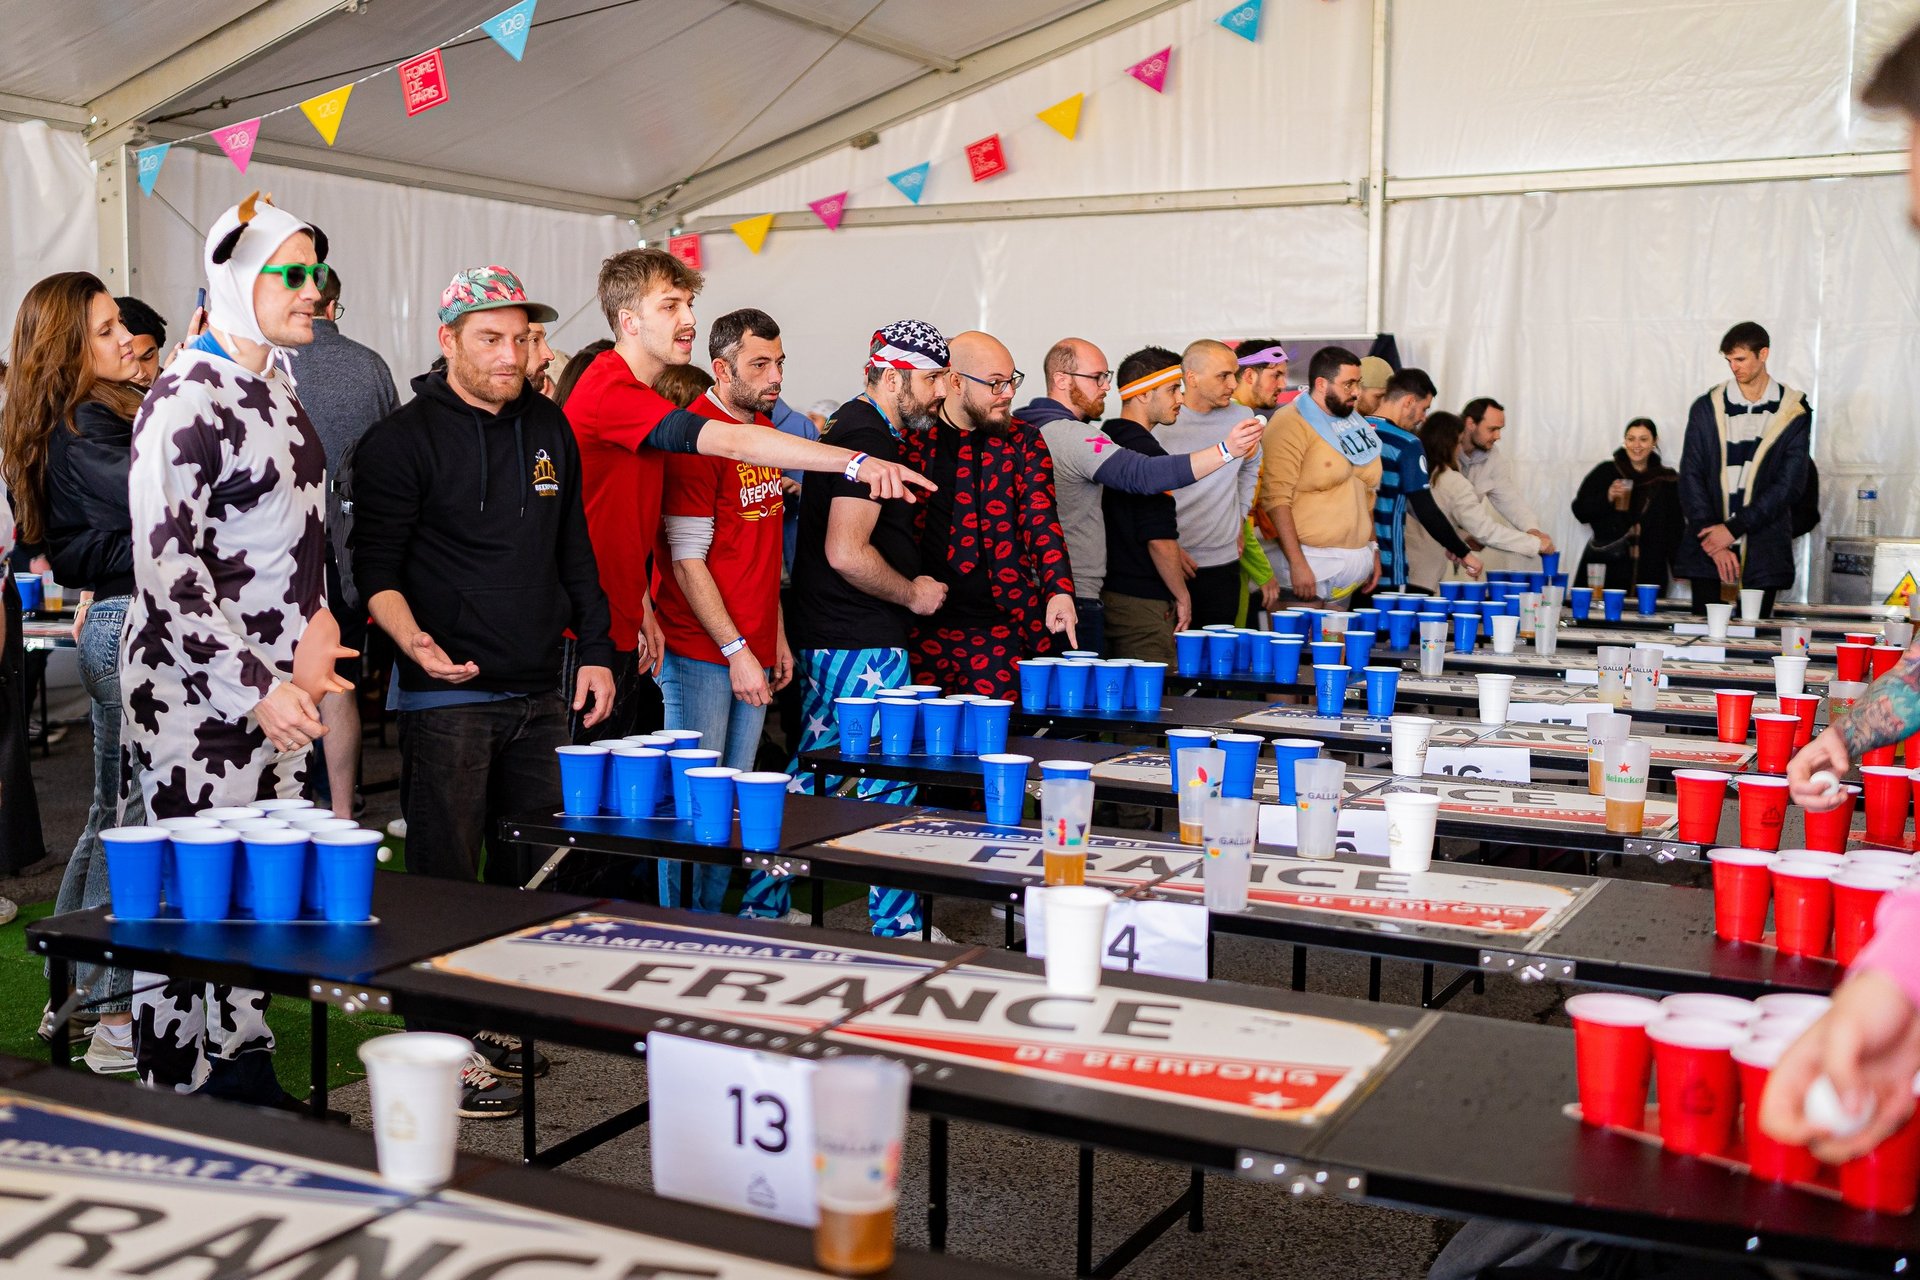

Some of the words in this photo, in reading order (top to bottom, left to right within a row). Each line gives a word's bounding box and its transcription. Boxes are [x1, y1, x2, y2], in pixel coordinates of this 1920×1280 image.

[405, 58, 436, 80] FOIRE
[408, 77, 424, 93] DE
[228, 130, 250, 150] 120
[1602, 664, 1624, 672] GALLIA
[1606, 773, 1645, 785] Heineken
[1307, 791, 1339, 801] GALLIA
[898, 826, 1104, 848] CHAMPIONT
[1112, 841, 1150, 849] DE
[541, 931, 808, 961] CHAMPIONNAT
[809, 948, 859, 963] DE
[1107, 924, 1141, 971] 4
[606, 962, 1182, 1041] FRANCE
[1014, 1044, 1068, 1064] DE
[1082, 1050, 1320, 1087] BEERPONG
[727, 1085, 790, 1154] 13
